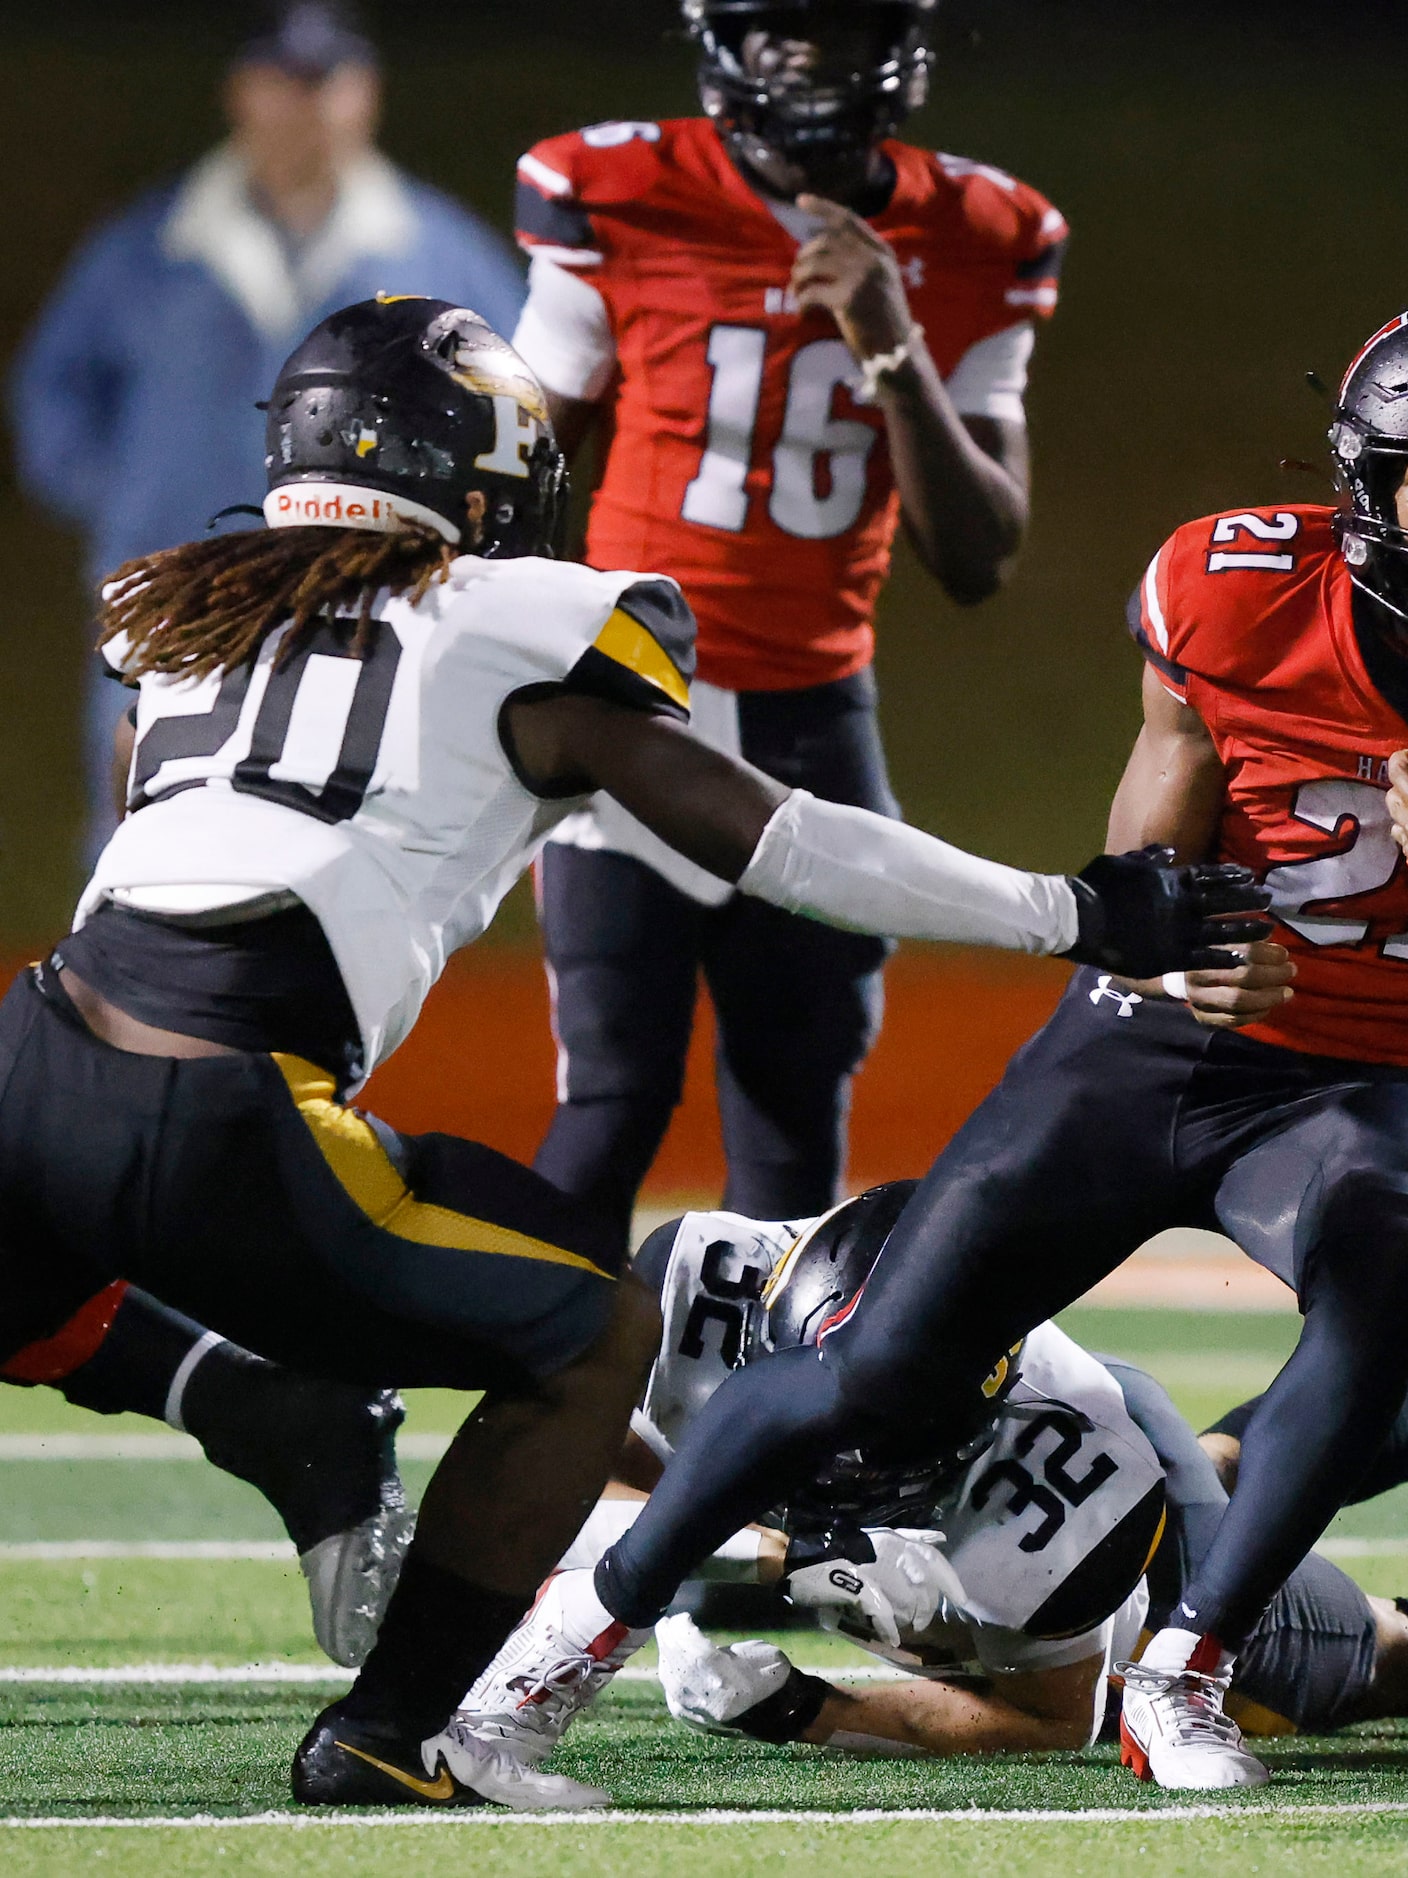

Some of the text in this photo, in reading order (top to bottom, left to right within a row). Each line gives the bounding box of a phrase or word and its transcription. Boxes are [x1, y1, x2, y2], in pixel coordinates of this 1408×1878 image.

[680, 321, 880, 540] 16
[1205, 512, 1299, 575] 21
[126, 615, 404, 826] 20
[970, 1411, 1120, 1554] 32
